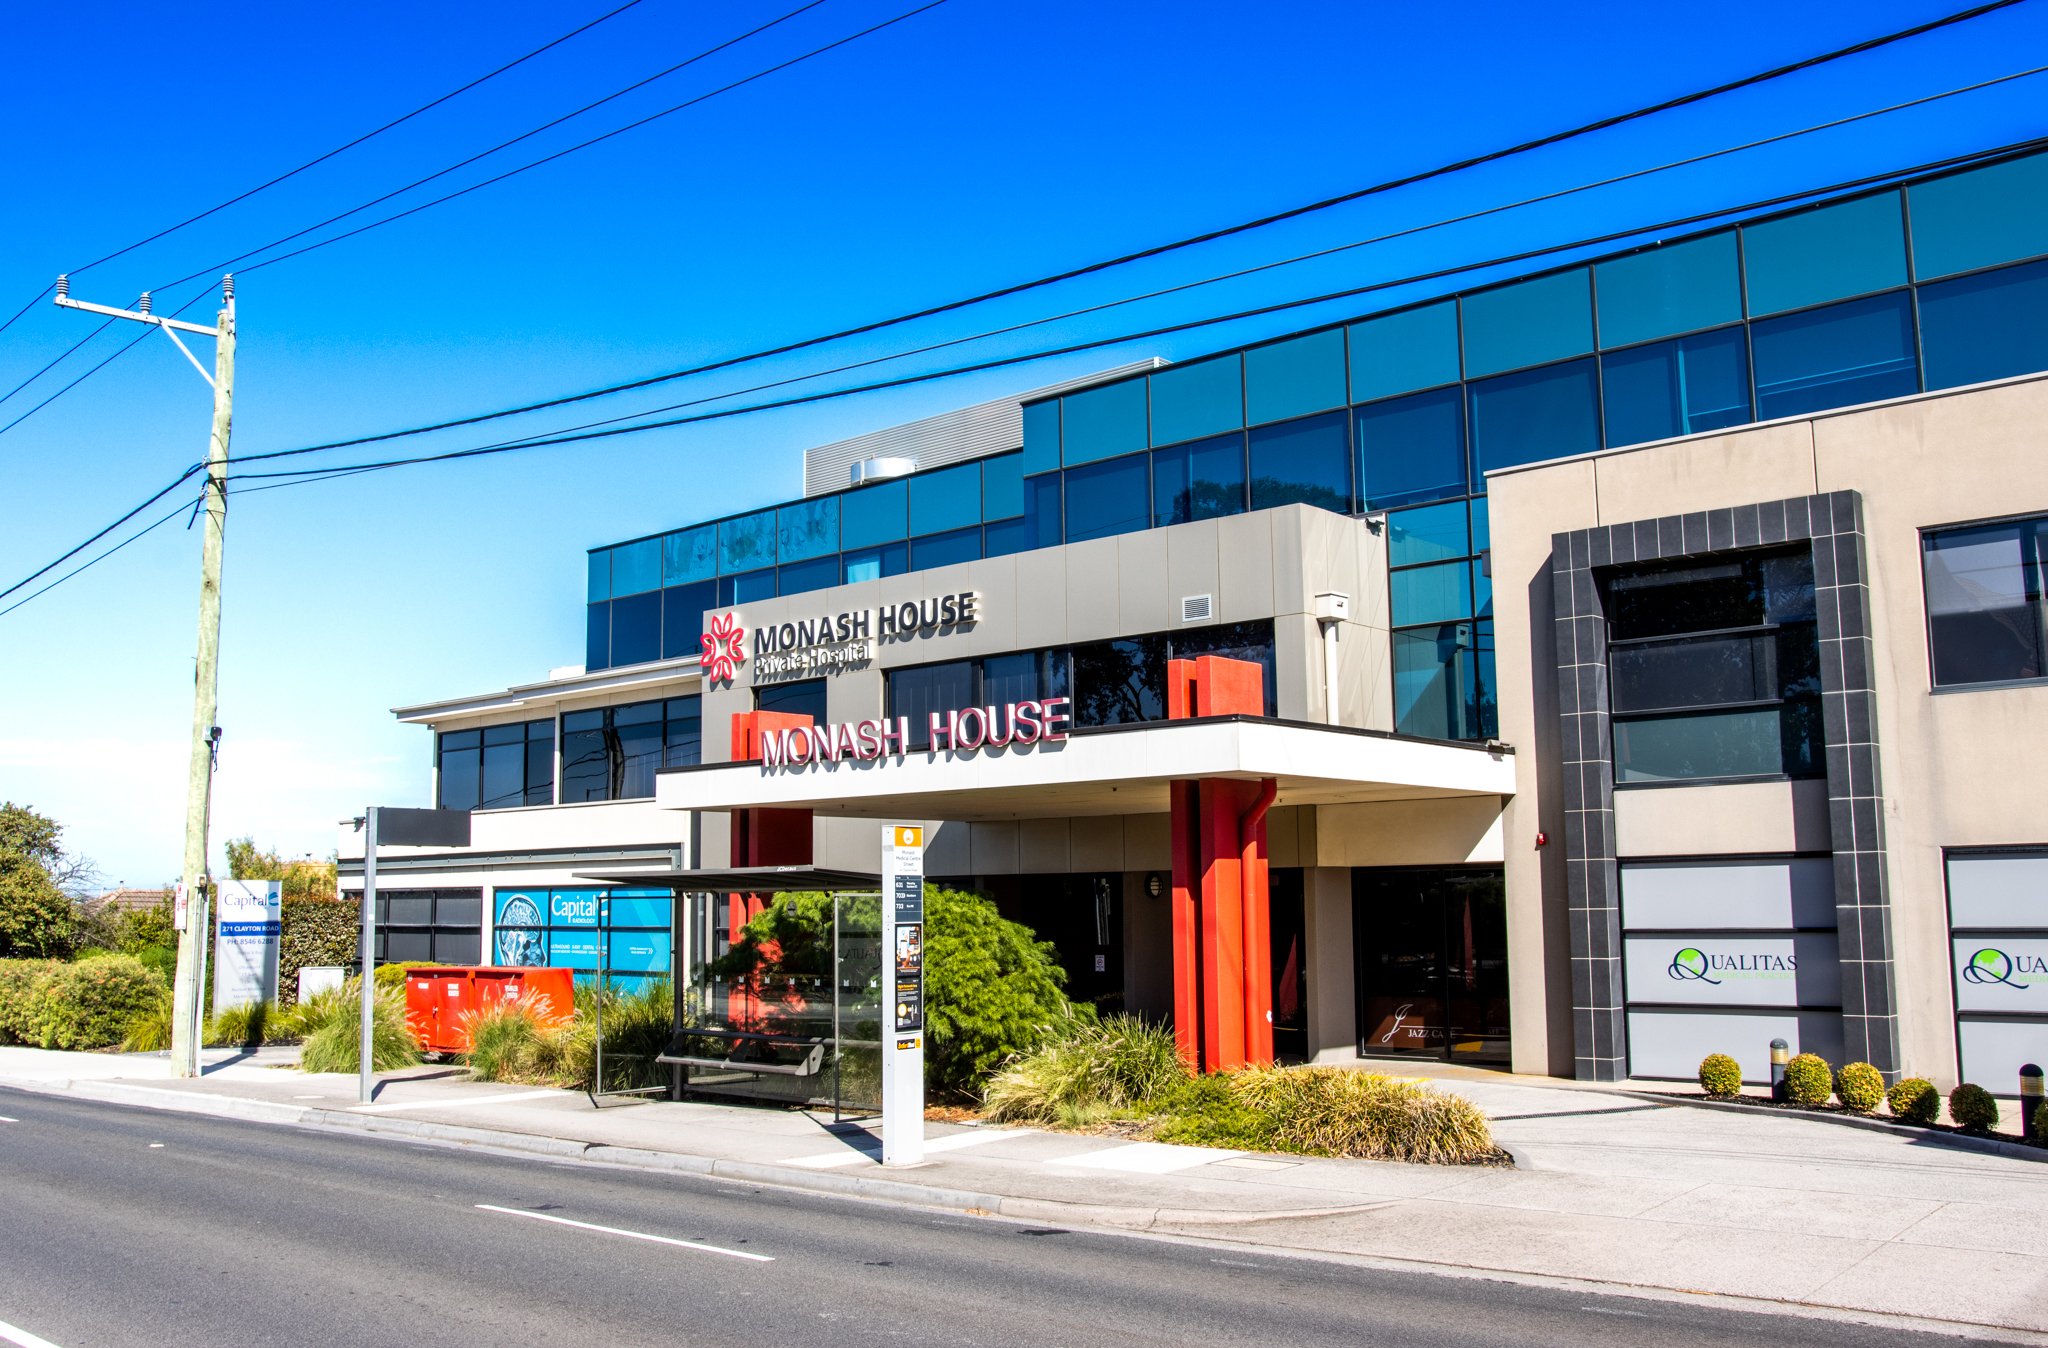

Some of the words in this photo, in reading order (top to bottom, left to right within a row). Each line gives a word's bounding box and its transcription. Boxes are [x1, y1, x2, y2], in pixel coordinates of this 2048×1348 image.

[754, 609, 871, 655] MONASH
[879, 591, 976, 636] HOUSE
[754, 652, 808, 675] Private
[809, 641, 871, 669] Hospital
[761, 716, 909, 768] MONASH
[929, 697, 1070, 752] HOUSE
[224, 893, 268, 910] Capital
[551, 894, 596, 923] Capital
[1668, 947, 1799, 985] QUALITAS
[1407, 1028, 1430, 1039] JAZZ
[1431, 1029, 1457, 1040] CAE
